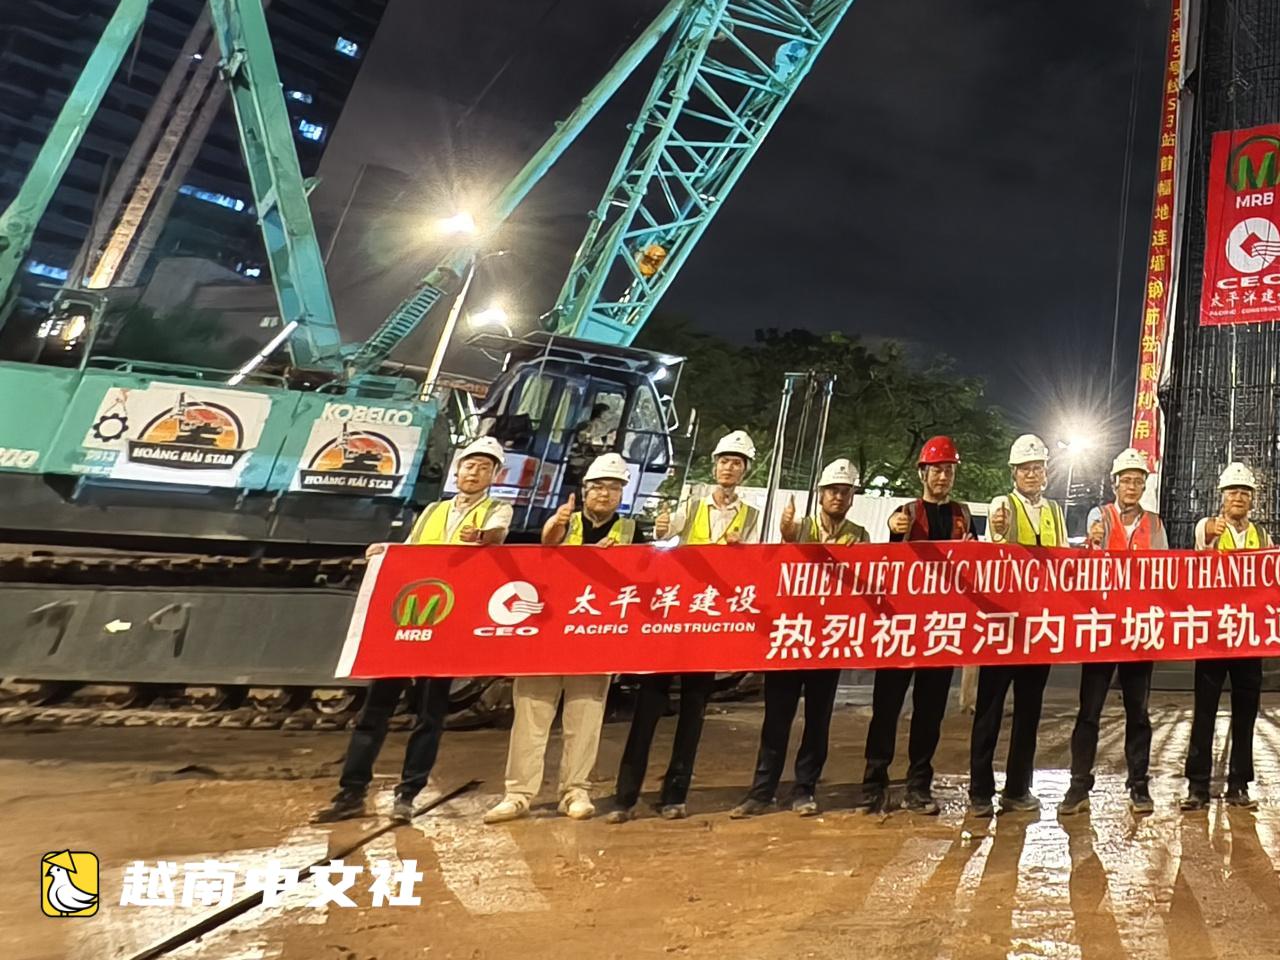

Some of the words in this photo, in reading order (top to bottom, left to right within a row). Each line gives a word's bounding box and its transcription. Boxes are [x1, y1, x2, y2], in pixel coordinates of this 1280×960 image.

[1236, 192, 1274, 209] MRB
[322, 402, 414, 426] KOBELCO
[204, 453, 235, 465] STAR
[776, 557, 850, 606] NHIỆT
[850, 556, 903, 605] LIỆT
[907, 550, 970, 595] CHÚC
[972, 549, 1040, 594] MỪNG
[1043, 552, 1132, 601] NGHIỆM
[1137, 556, 1179, 590] THU
[568, 584, 762, 618] 太平洋建设
[394, 628, 432, 642] MRB
[473, 626, 539, 636] CEO
[563, 623, 629, 635] PACIFIC
[641, 621, 756, 634] CONSTRUCTION
